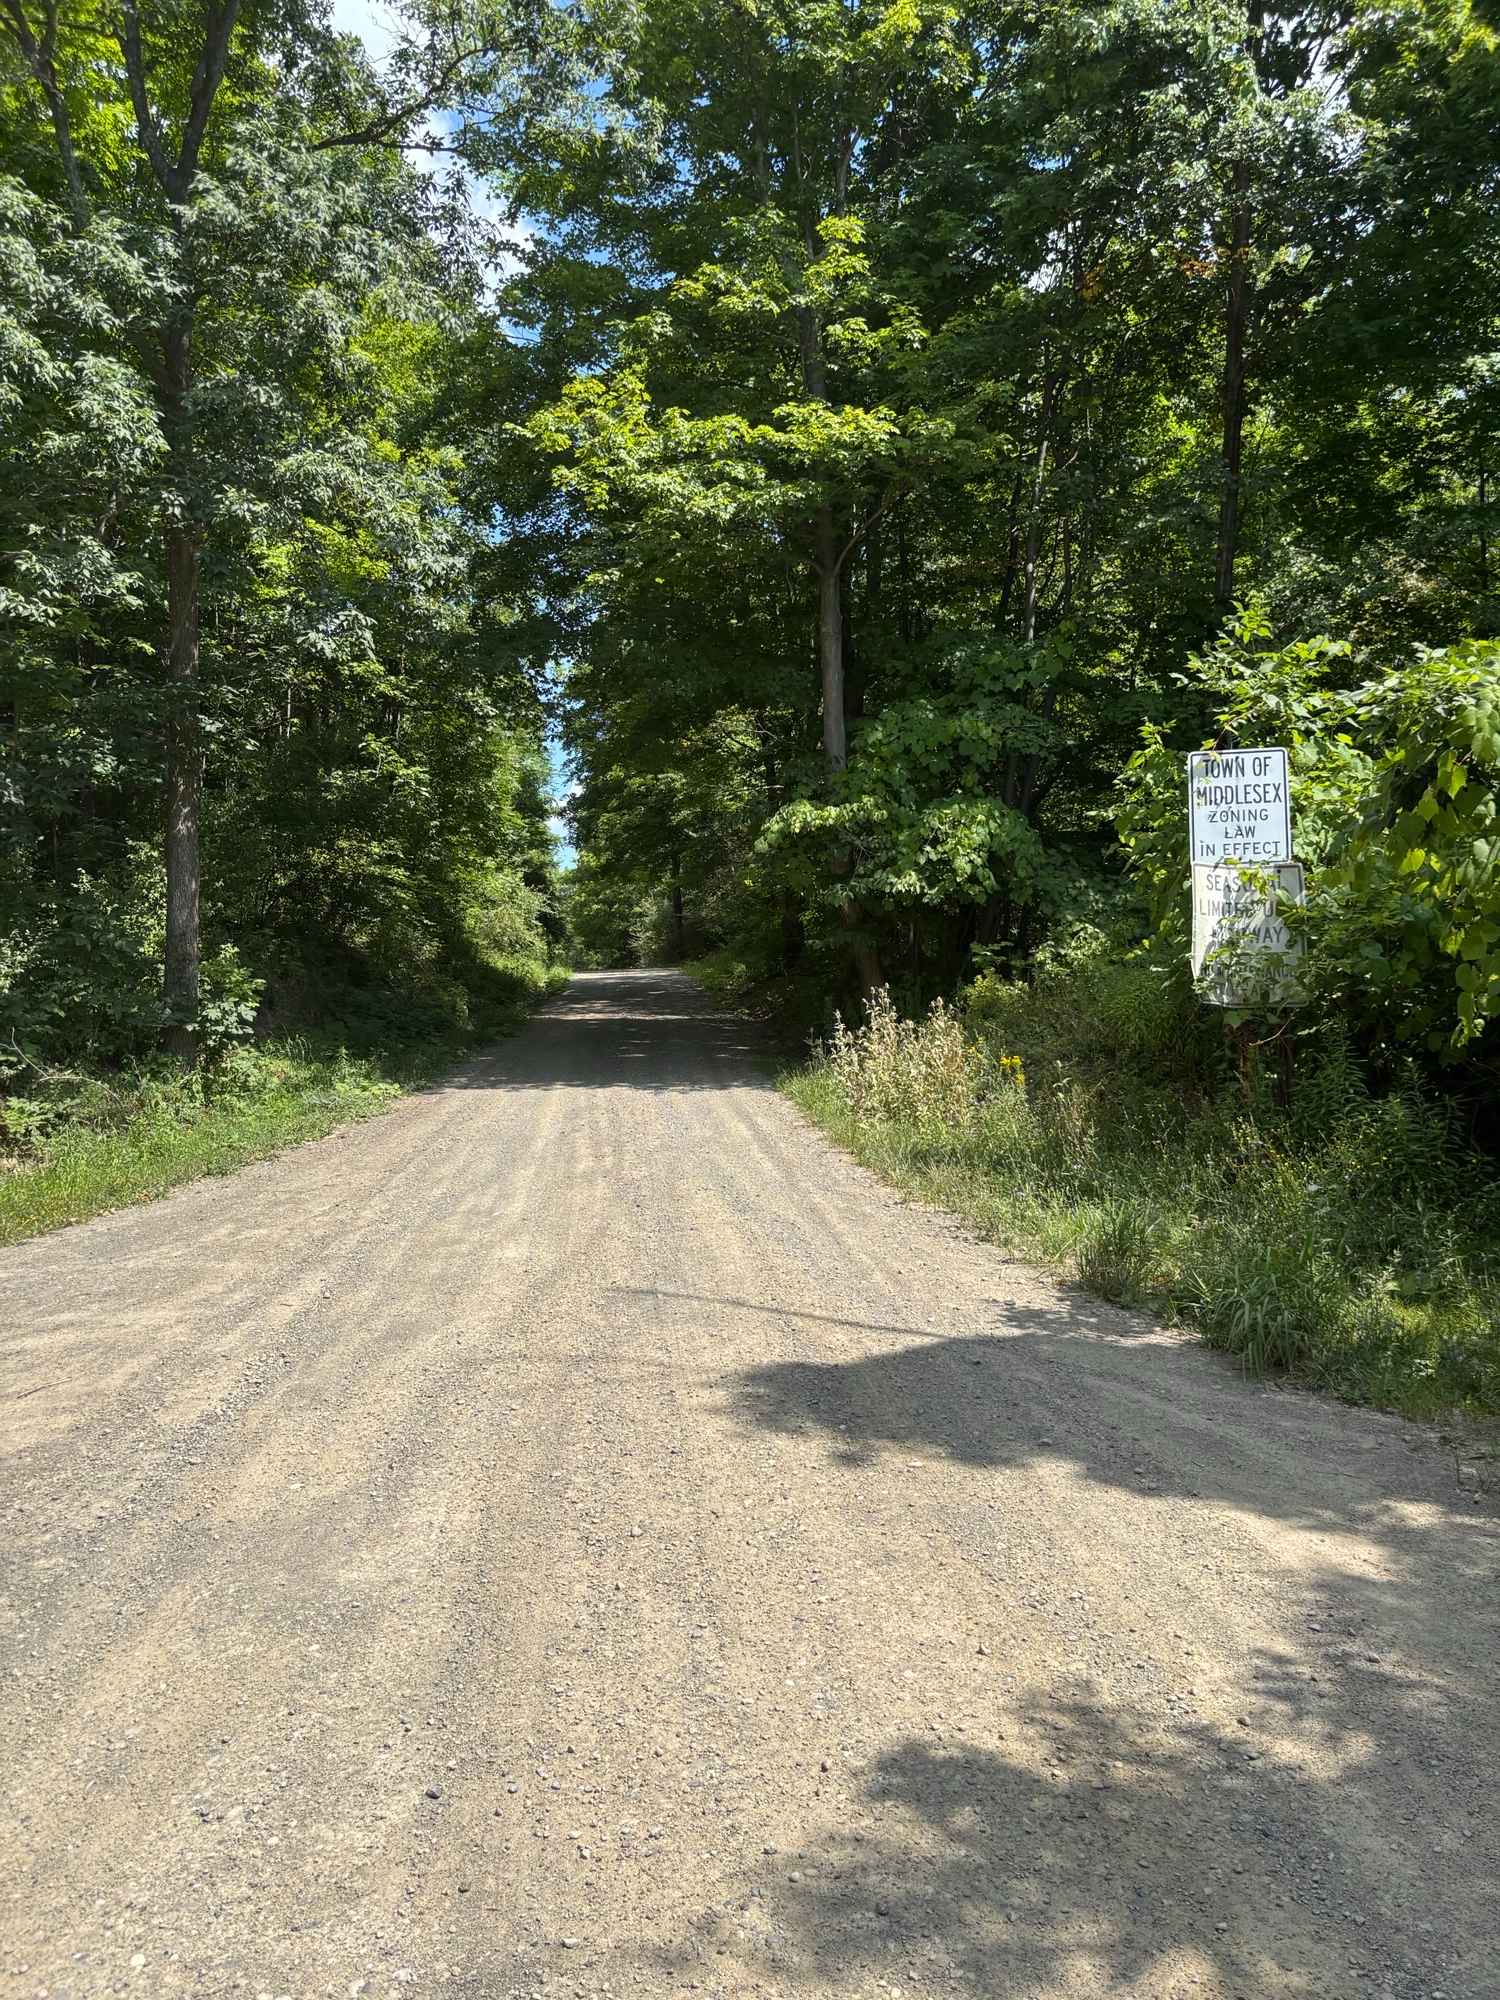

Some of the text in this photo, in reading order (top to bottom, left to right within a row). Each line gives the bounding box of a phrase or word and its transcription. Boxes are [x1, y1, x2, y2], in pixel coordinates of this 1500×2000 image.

[1202, 757, 1272, 778] TOWN OF
[1197, 783, 1283, 806] MIDDLESEX
[1209, 809, 1269, 822] ZONING
[1224, 826, 1256, 838] LAW
[1201, 842, 1281, 856] IN EFFECT
[1200, 900, 1255, 918] LIMITE
